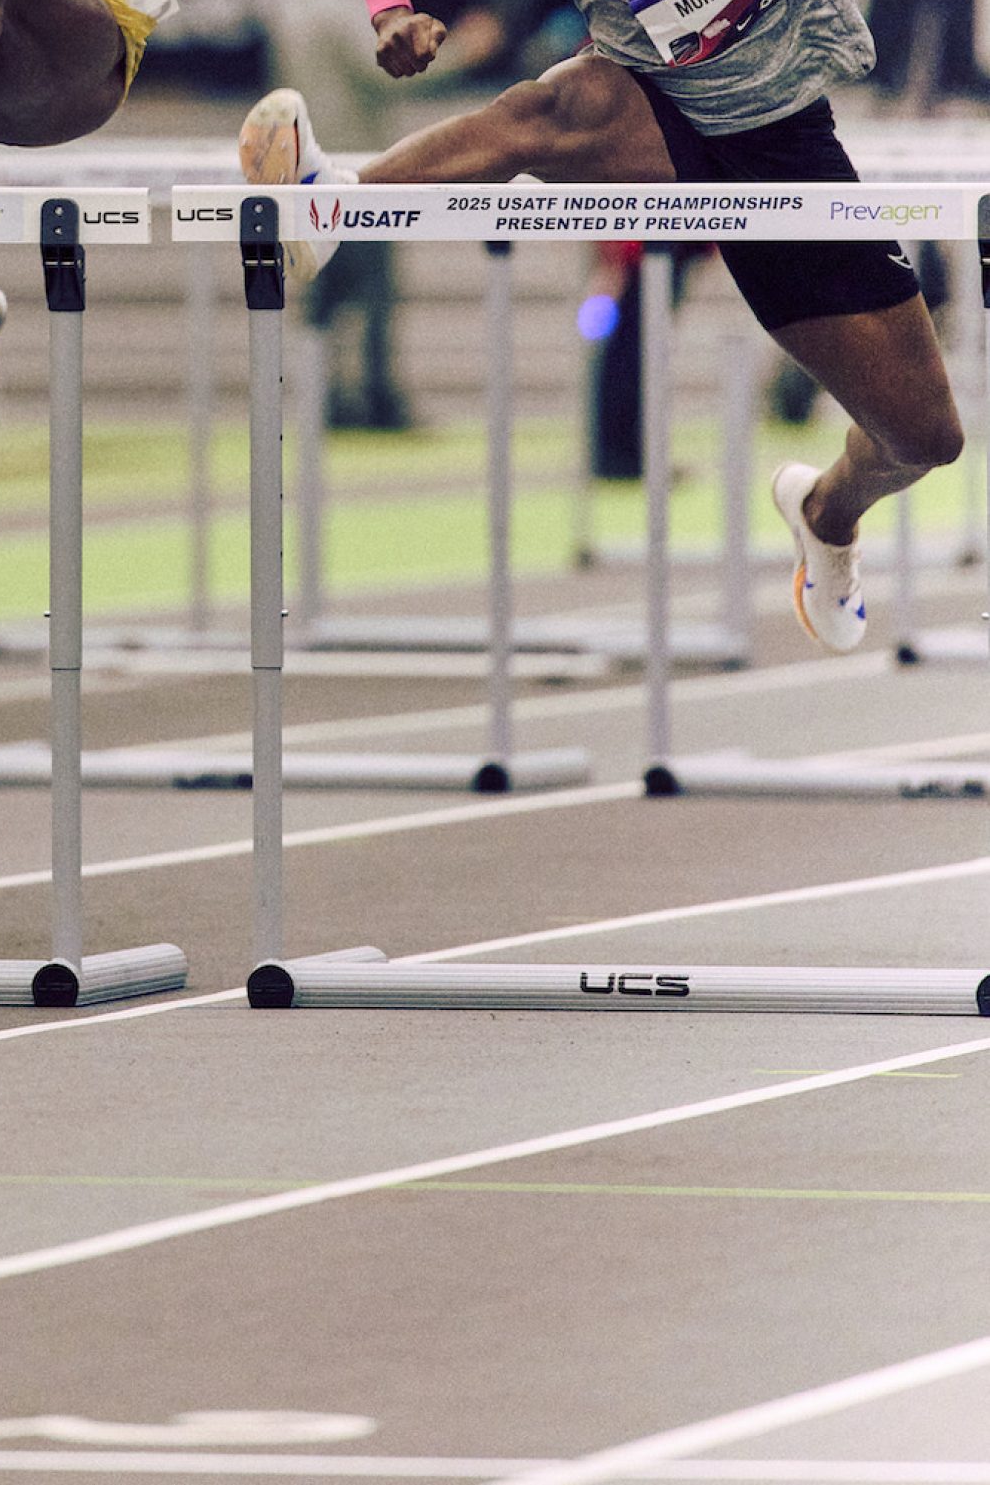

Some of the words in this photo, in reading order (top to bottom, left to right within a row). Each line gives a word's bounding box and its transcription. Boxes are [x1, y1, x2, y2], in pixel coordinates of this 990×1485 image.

[446, 197, 491, 211] 2025
[497, 197, 558, 211] USATF
[563, 197, 638, 211] INDOOR
[643, 197, 803, 211] CHAMPIONSHIPS
[83, 211, 139, 224] UCS
[177, 207, 234, 221] UCS
[343, 210, 421, 228] USATF
[830, 201, 939, 226] Prevagen
[496, 217, 607, 230] PRESENTED
[613, 217, 639, 230] BY
[645, 217, 748, 230] PREVAGEN
[580, 972, 690, 997] UCS
